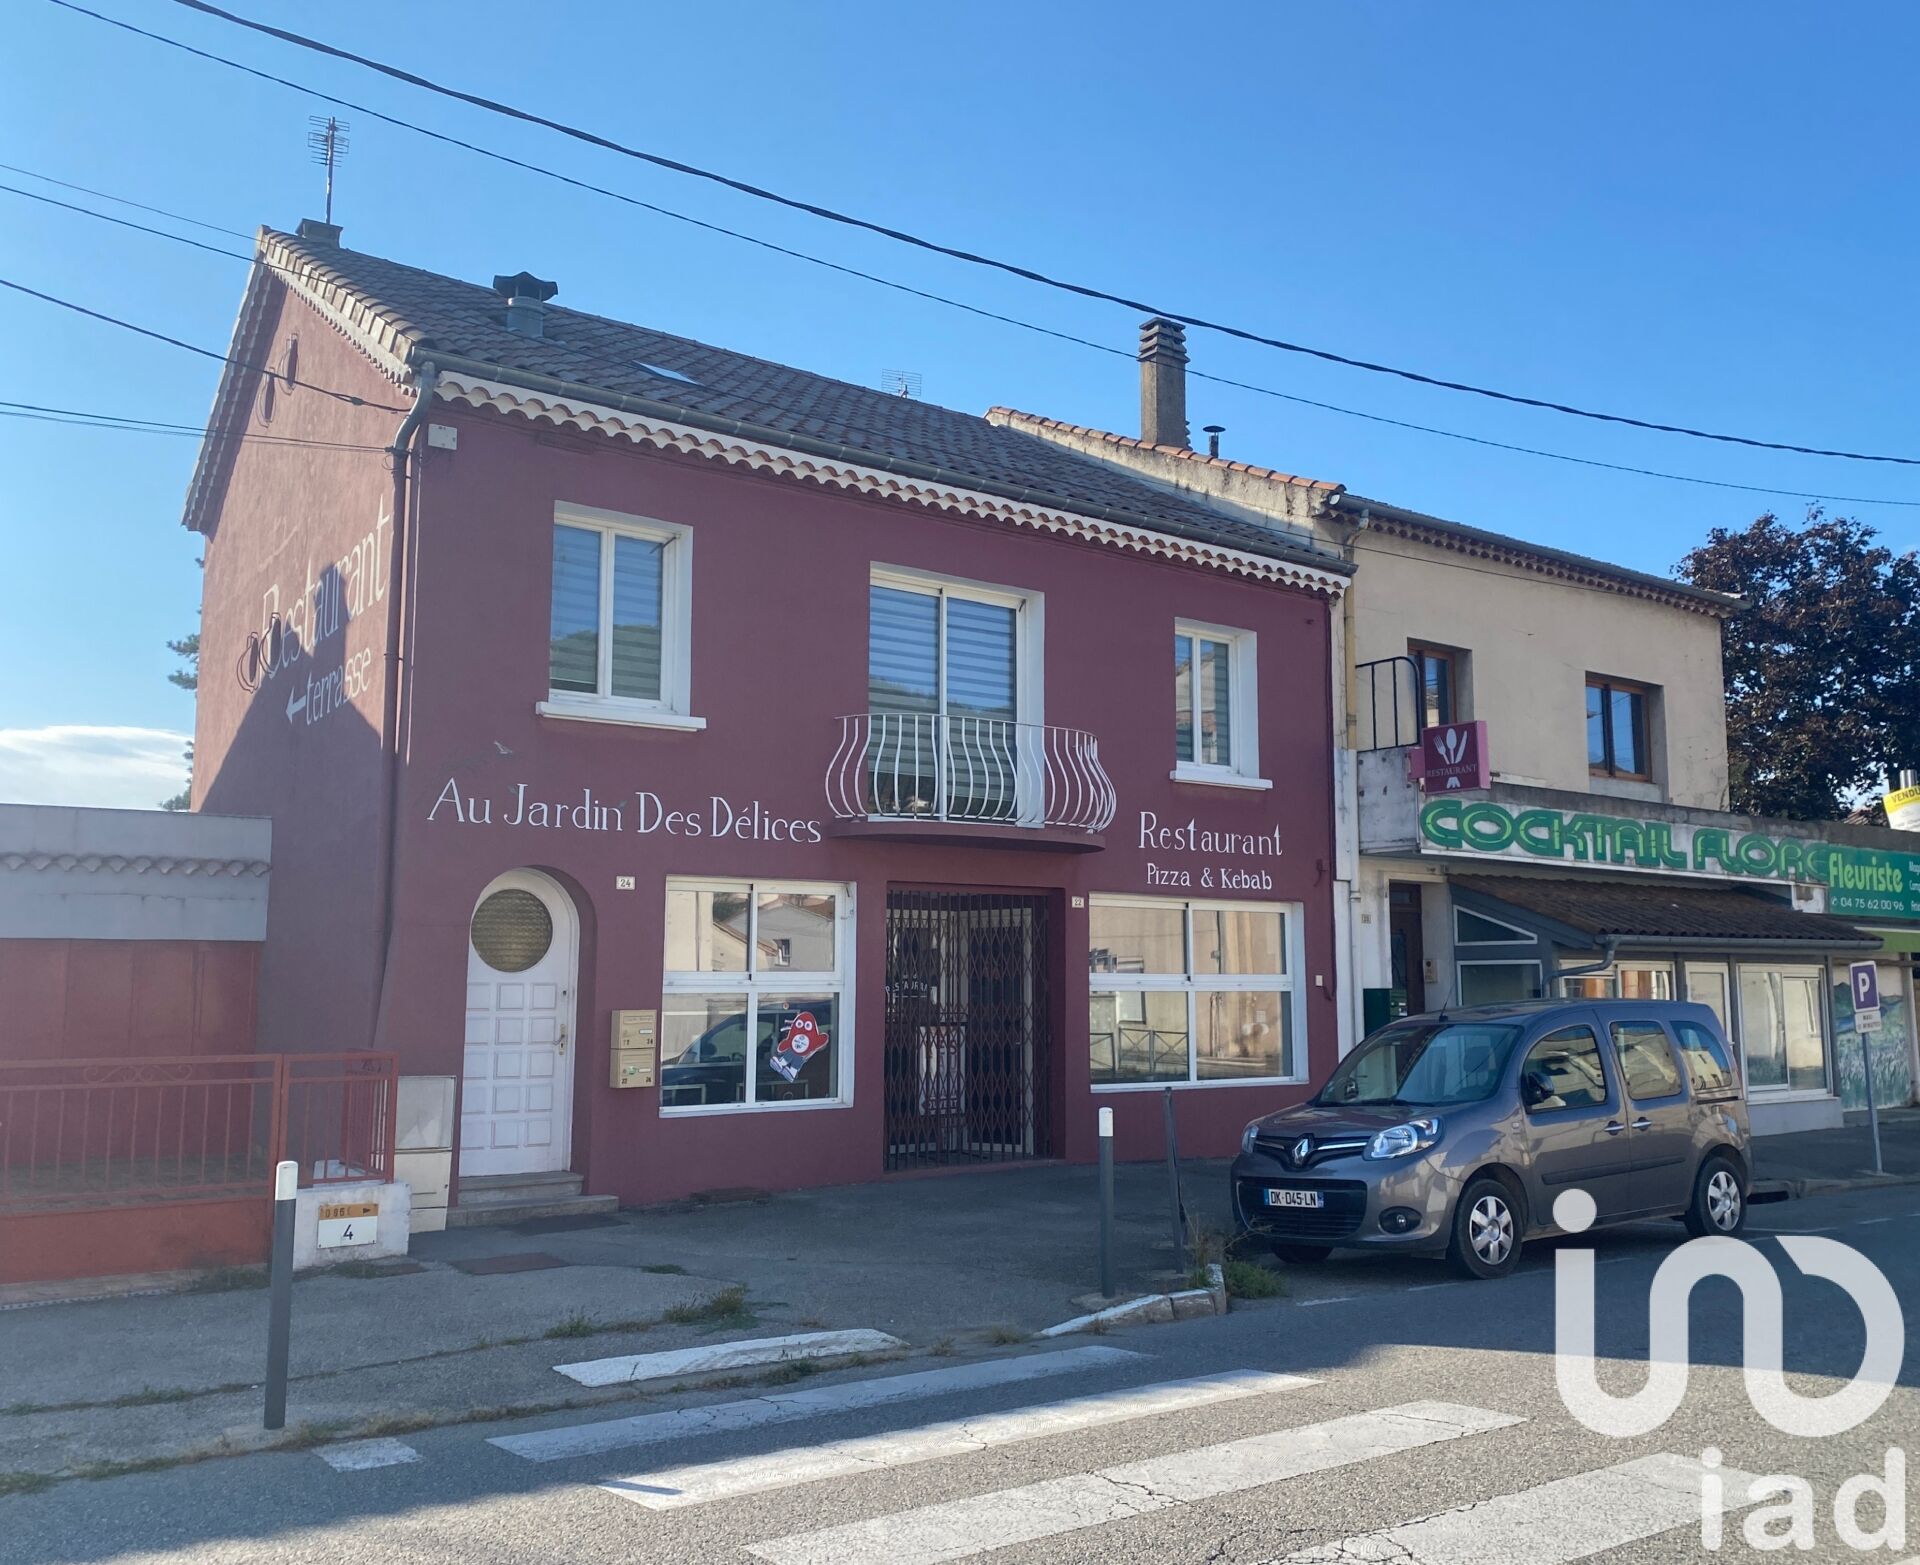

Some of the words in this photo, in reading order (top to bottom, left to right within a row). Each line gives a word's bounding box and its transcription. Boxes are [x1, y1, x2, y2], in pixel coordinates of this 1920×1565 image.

[259, 494, 391, 687] Restaurant
[306, 647, 372, 725] terrasse
[1427, 763, 1477, 778] RESTAURANT
[427, 777, 492, 825] Au
[504, 784, 623, 831] Jardin
[635, 792, 702, 837] Des
[710, 797, 822, 844] Délices
[1138, 811, 1283, 857] Restaurant
[1420, 799, 1687, 868] COCKTAIL
[620, 878, 631, 888] 24
[1147, 863, 1192, 887] Pizza
[1201, 868, 1214, 888] &
[1220, 868, 1272, 890] Kebab
[1840, 897, 1853, 907] 04
[1855, 898, 1866, 908] 75
[1867, 899, 1879, 910] 62
[1881, 900, 1892, 910] 00
[1893, 902, 1904, 912] 96
[1858, 972, 1871, 1002] P
[342, 1223, 354, 1240] 4
